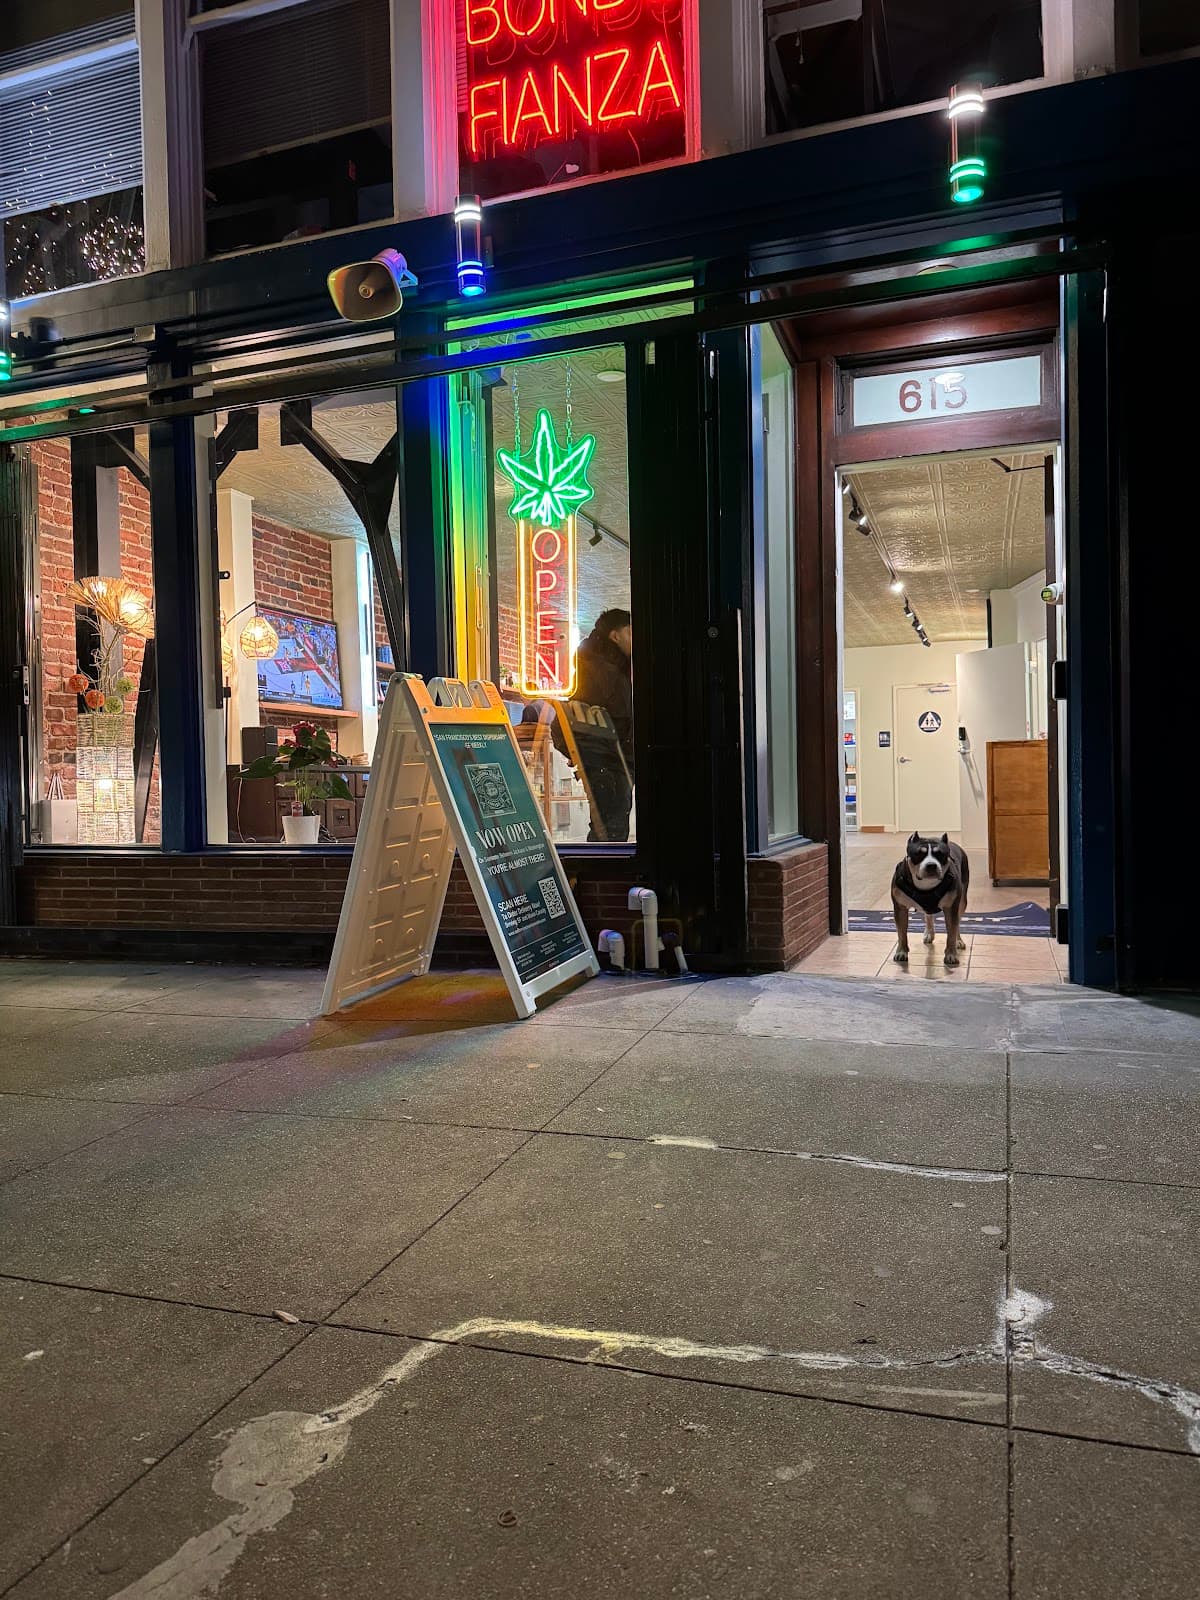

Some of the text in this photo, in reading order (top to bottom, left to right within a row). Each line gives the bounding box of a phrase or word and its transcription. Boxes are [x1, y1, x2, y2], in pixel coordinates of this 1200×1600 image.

[470, 40, 681, 153] FIANZA
[899, 373, 968, 413] 615
[532, 528, 562, 689] OPEN
[475, 821, 537, 849] NOW OPEN
[508, 857, 529, 870] ALMOST
[497, 894, 529, 912] SCAN HERE
